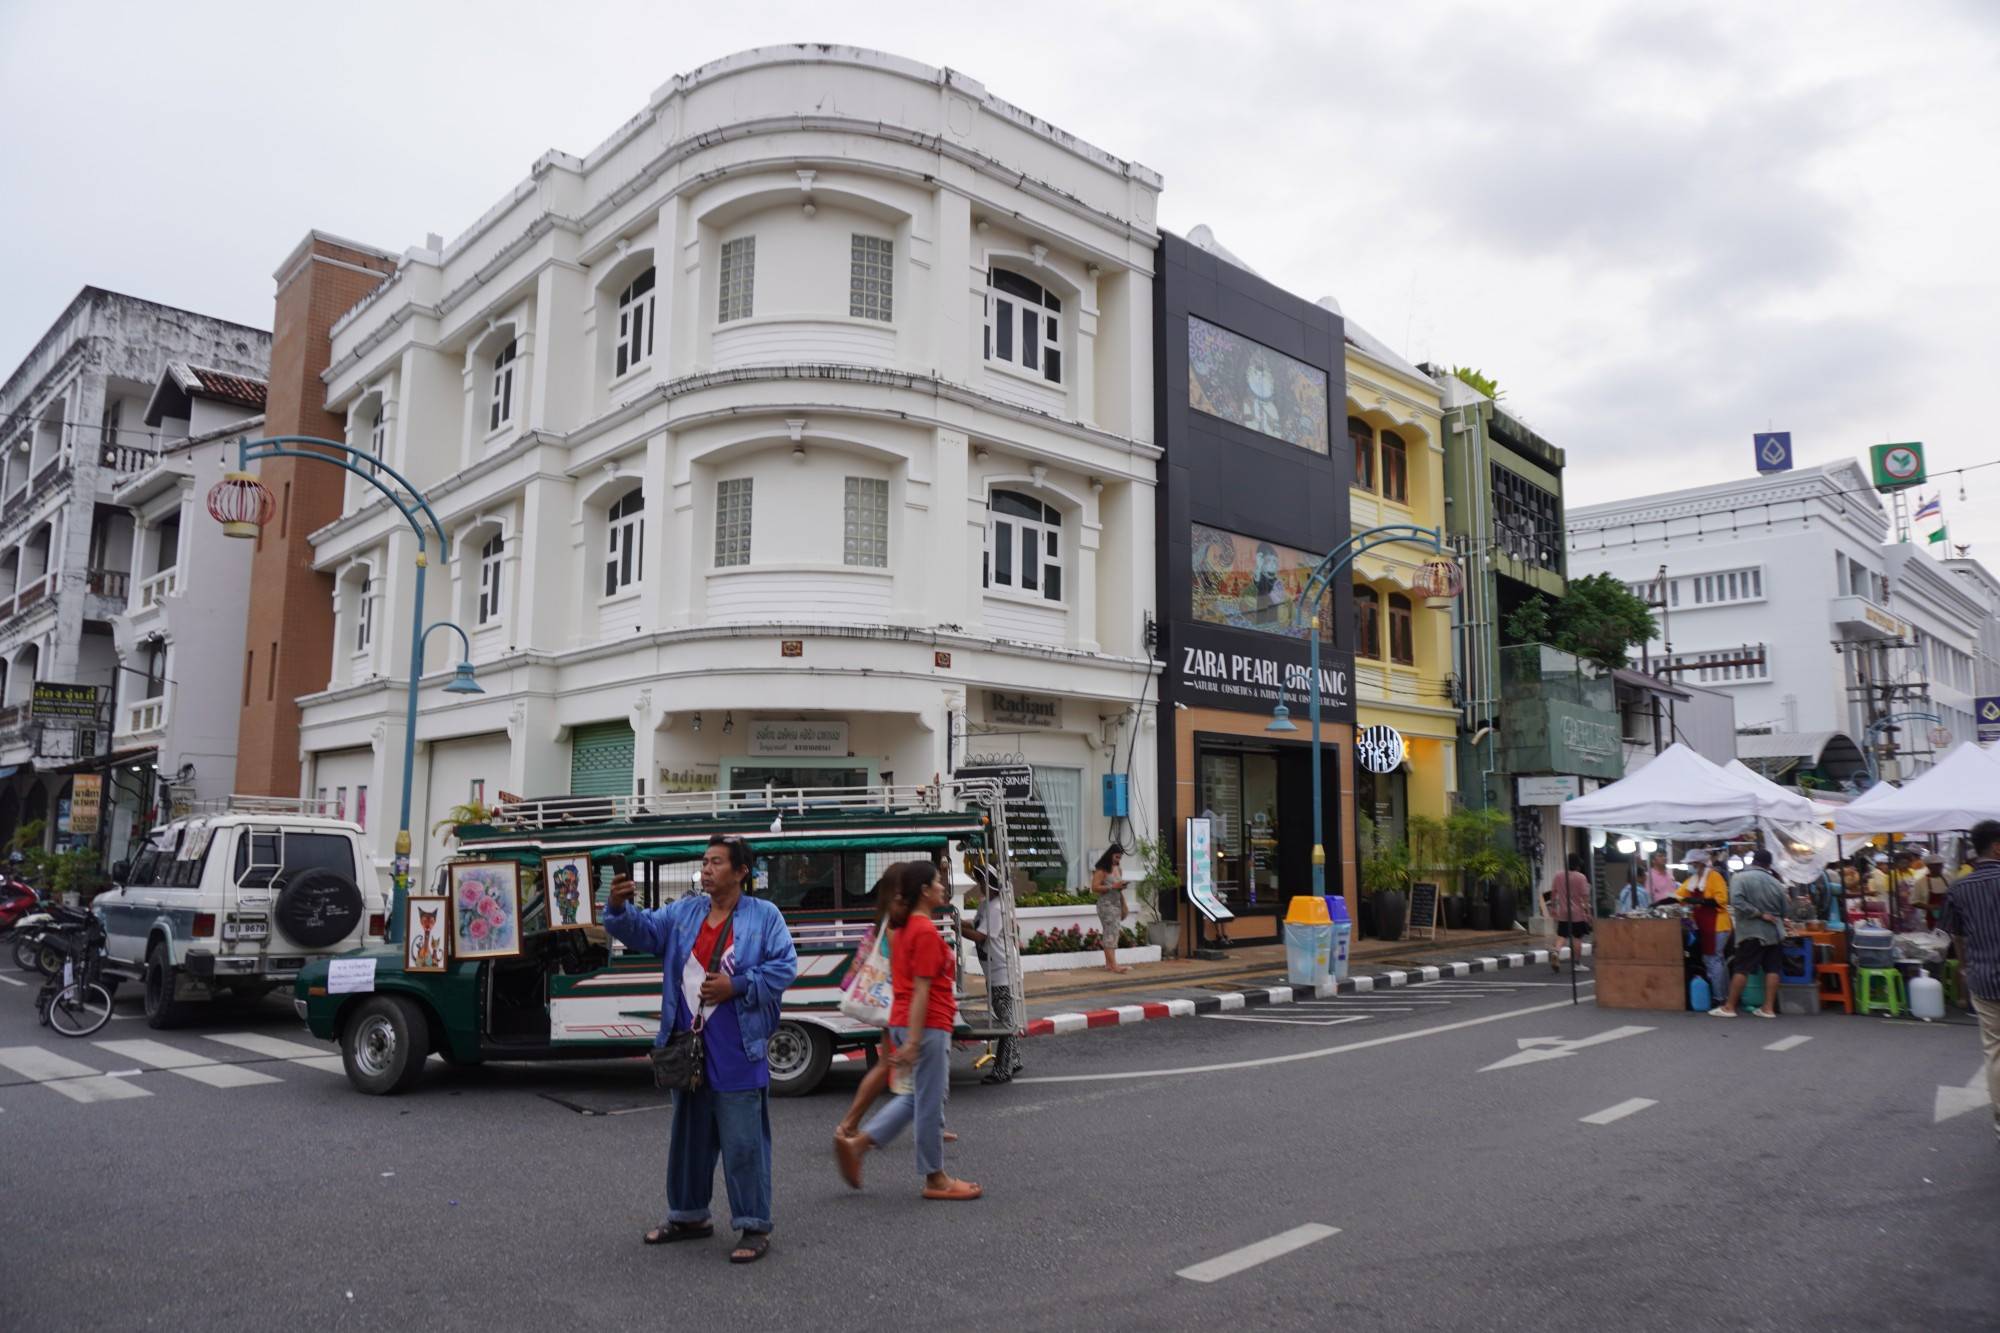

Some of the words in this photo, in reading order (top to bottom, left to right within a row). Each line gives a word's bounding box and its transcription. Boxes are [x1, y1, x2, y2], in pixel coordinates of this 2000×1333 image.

[1183, 647, 1228, 679] ZARA
[1232, 655, 1282, 687] PEARL
[1193, 679, 1219, 693] NATURAL
[1221, 683, 1253, 698] COSMETICS
[33, 705, 56, 713] WONG
[992, 693, 1057, 716] Radiant
[660, 768, 718, 784] Radiant
[245, 924, 265, 932] 9679
